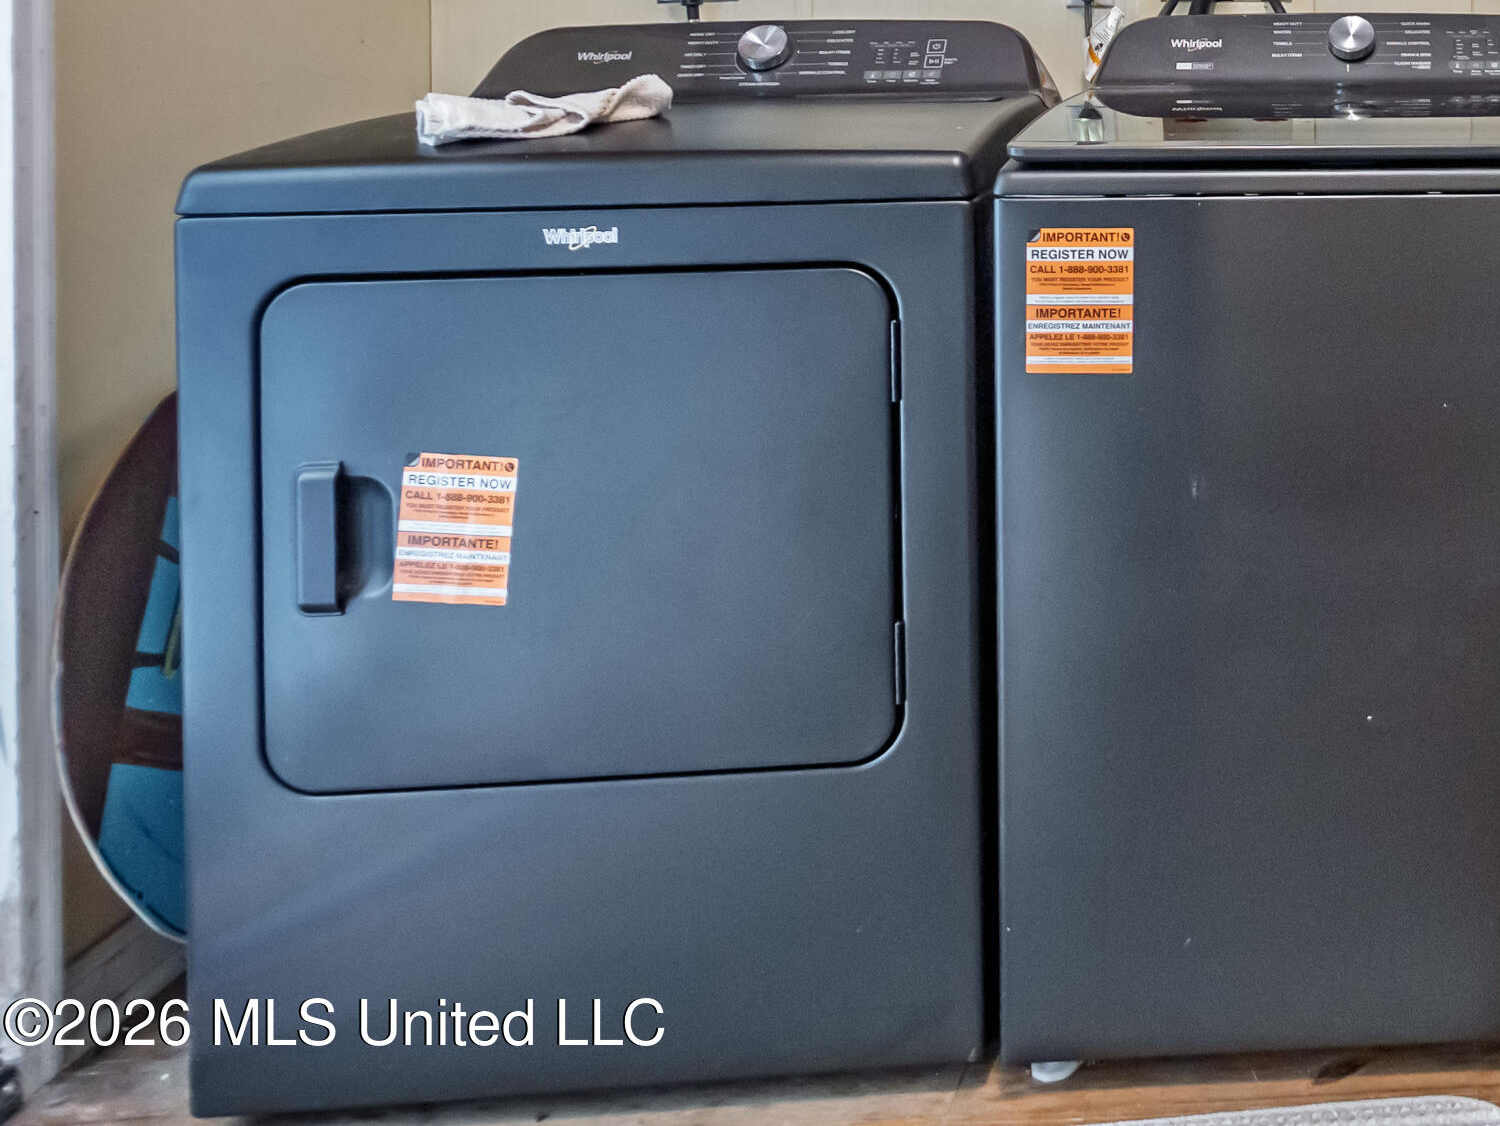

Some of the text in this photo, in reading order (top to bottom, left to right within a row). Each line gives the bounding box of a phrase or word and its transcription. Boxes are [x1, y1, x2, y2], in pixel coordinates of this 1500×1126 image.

[1171, 38, 1223, 51] Whirlpool
[577, 50, 632, 64] Whirlpool
[542, 226, 618, 250] Whirlpool
[1042, 232, 1120, 242] IMPORTANT!
[1031, 249, 1129, 260] REGISTER NOW
[1030, 265, 1129, 274] CALL 1-888-900-3381
[1036, 308, 1121, 318] IMPORTANTE!
[421, 457, 504, 471] IMPORTANT!
[408, 474, 512, 489] REGISTER NOW
[405, 490, 510, 504] CALL 1-888-900-3381
[408, 535, 499, 549] IMPORTANTE!
